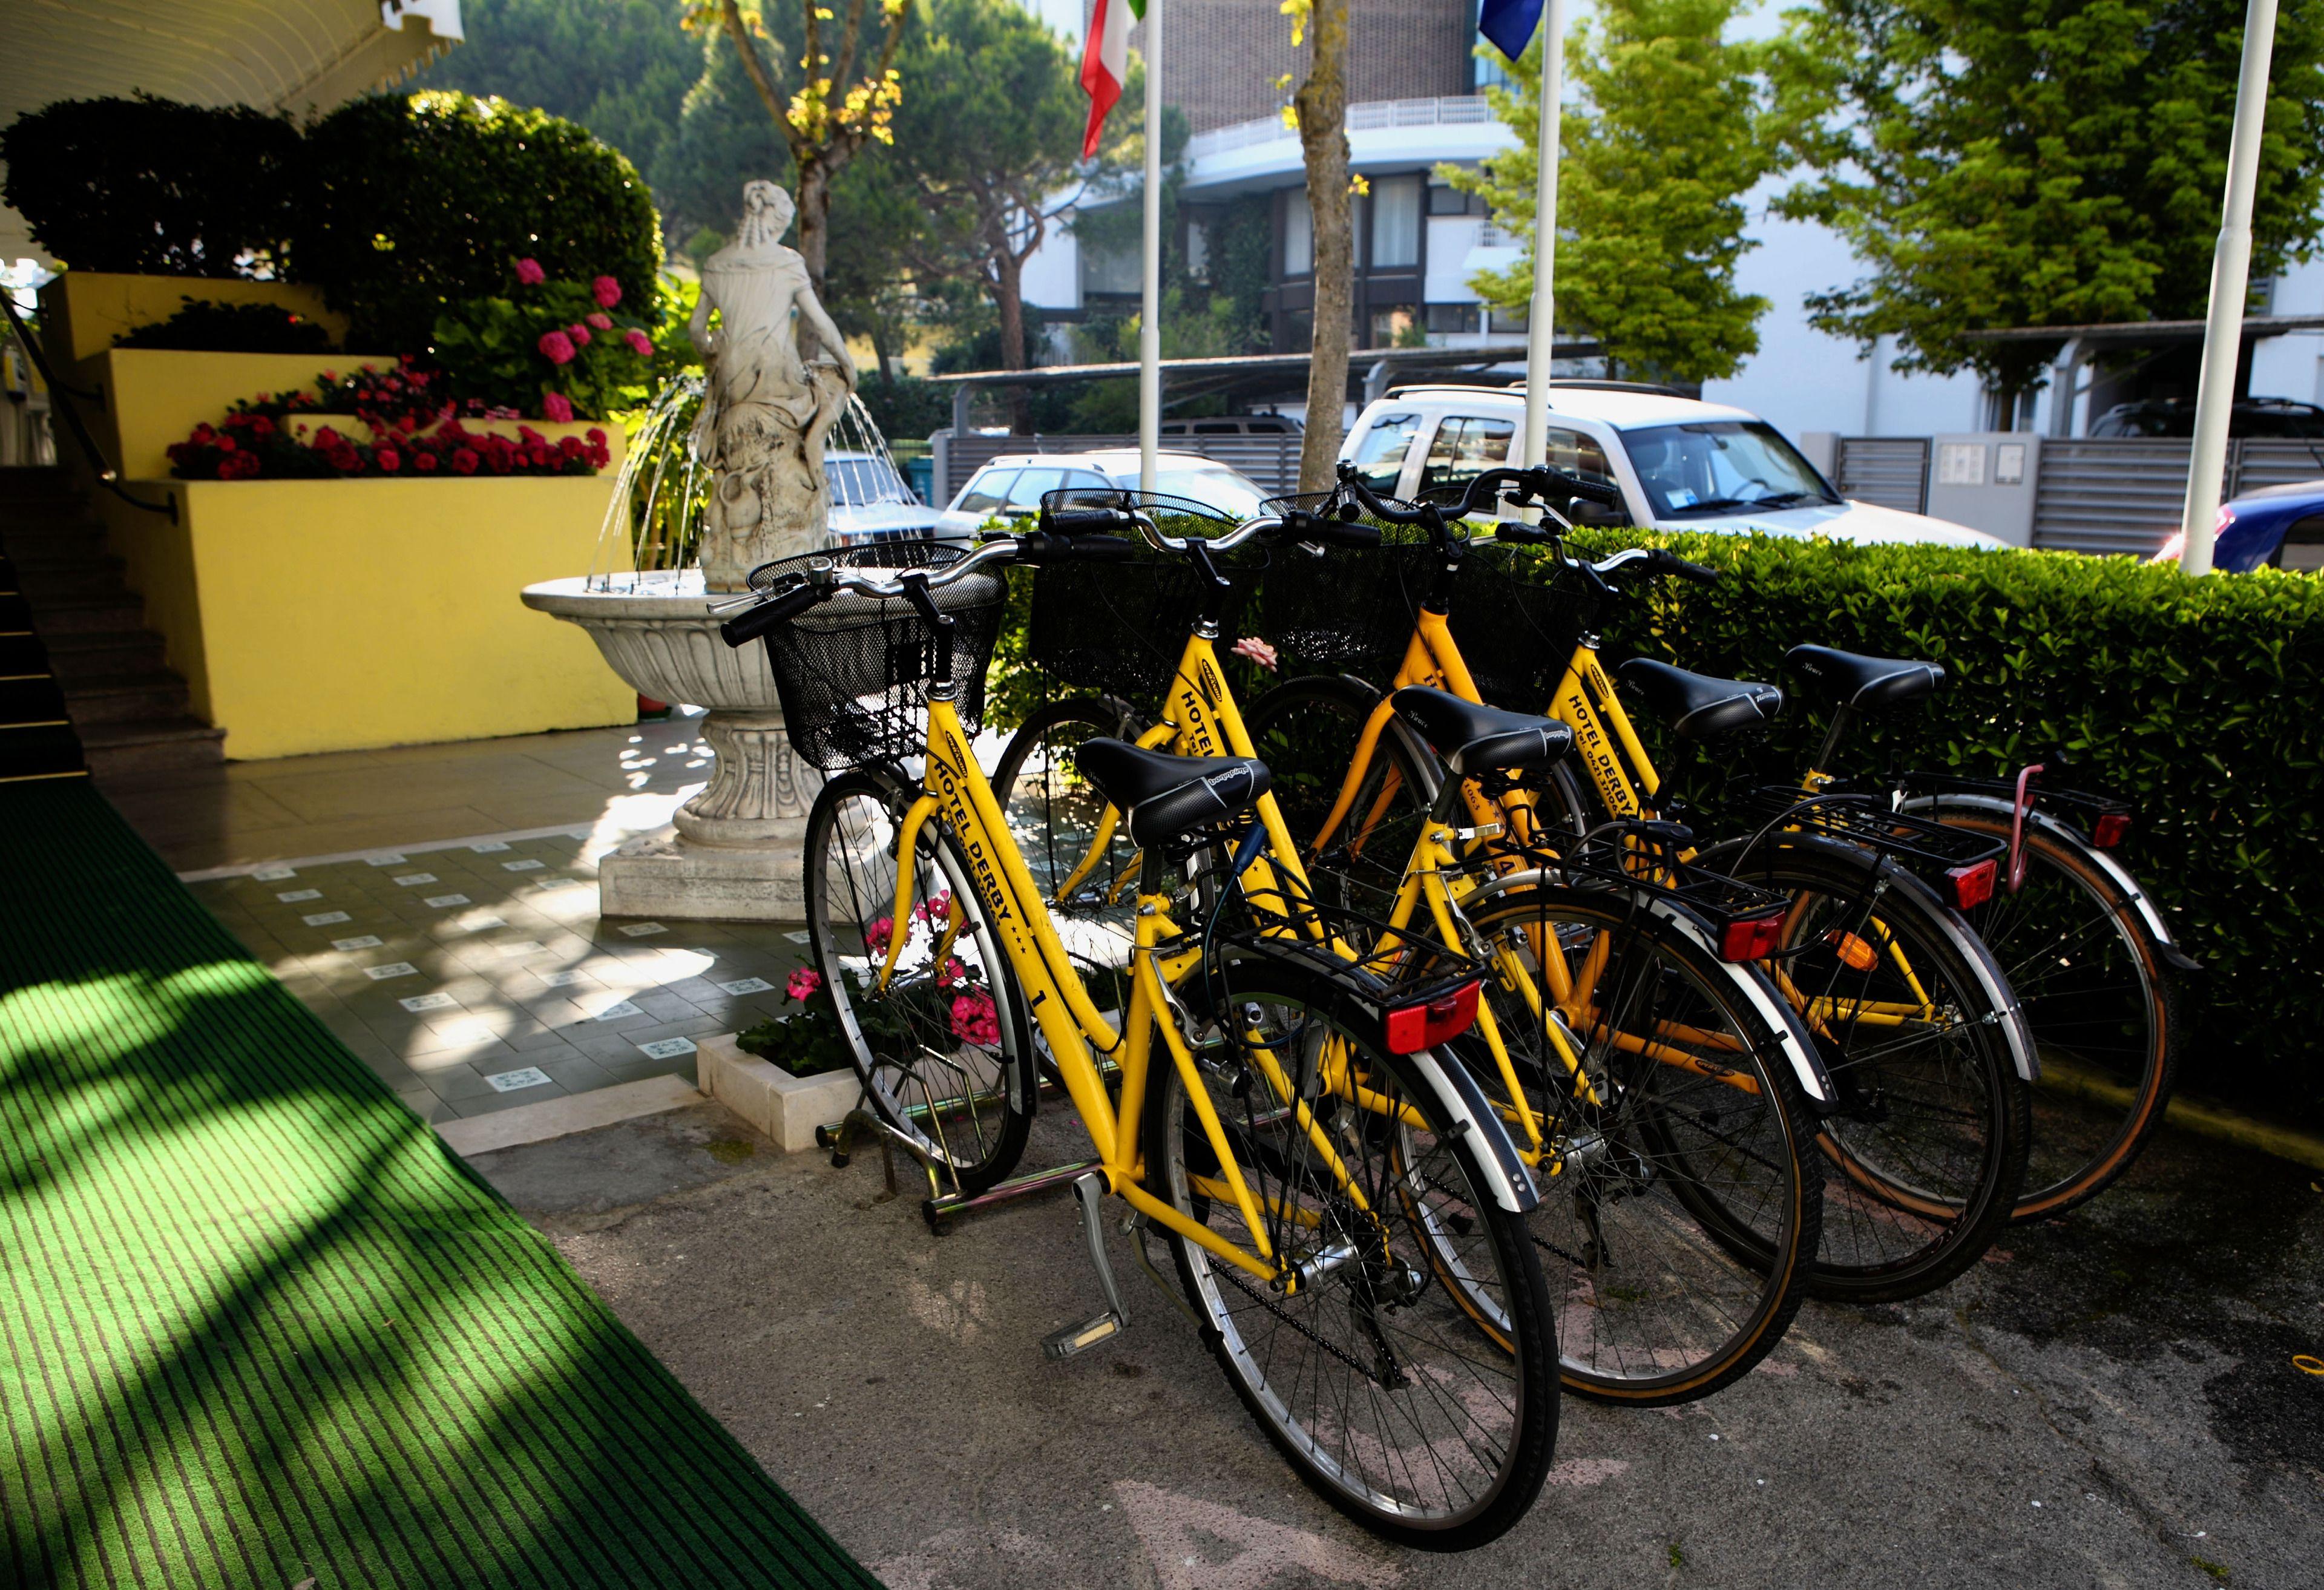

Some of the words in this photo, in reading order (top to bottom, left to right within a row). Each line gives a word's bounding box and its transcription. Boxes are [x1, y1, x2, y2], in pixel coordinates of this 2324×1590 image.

[1577, 729, 1586, 749] Tel.
[1568, 695, 1601, 749] HOTEL
[1597, 754, 1633, 812] DERBY
[934, 761, 971, 837] HOTEL
[970, 841, 1013, 919] DERBY
[1499, 861, 1515, 875] 4
[1032, 990, 1047, 1008] 1
